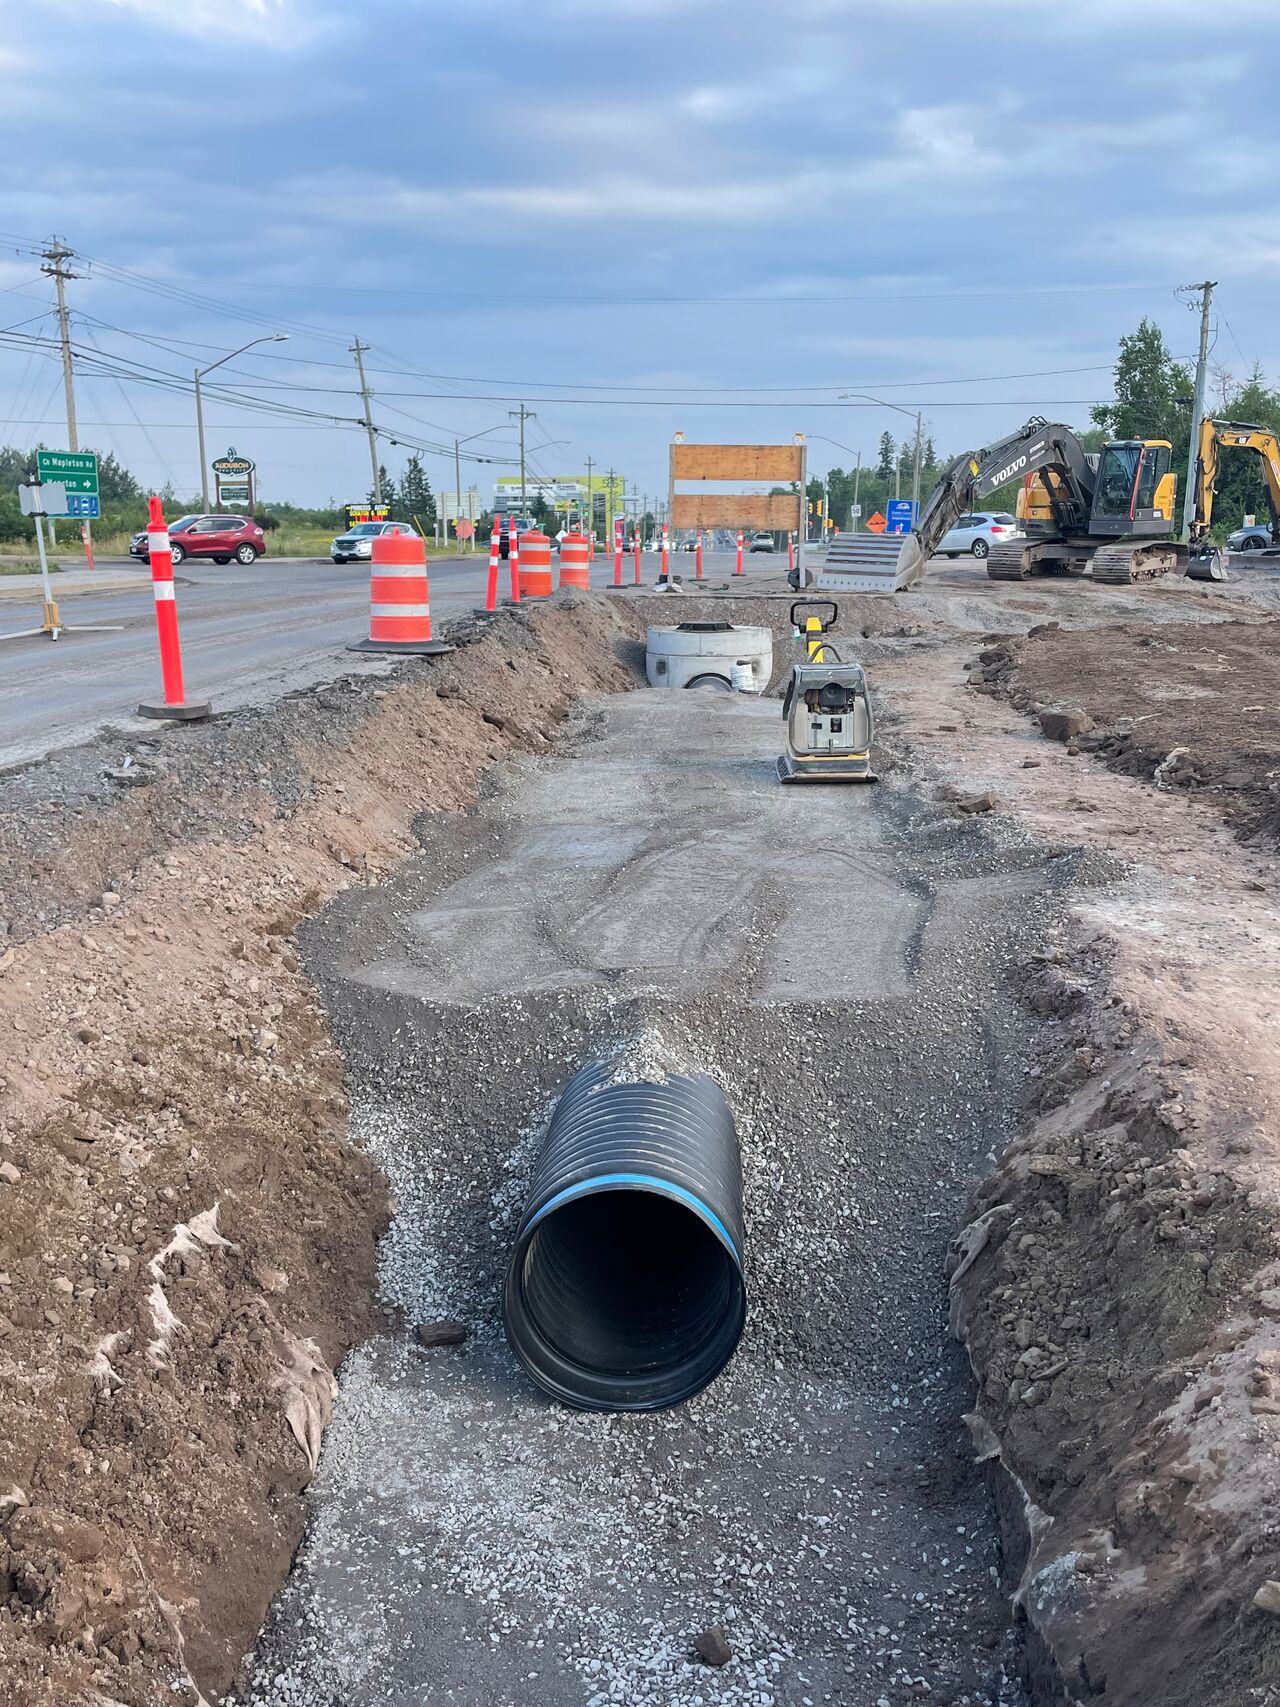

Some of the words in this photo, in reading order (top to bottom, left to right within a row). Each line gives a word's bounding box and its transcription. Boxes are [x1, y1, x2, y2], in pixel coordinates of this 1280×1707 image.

[52, 458, 84, 469] Mapleton
[85, 460, 93, 468] Rd
[991, 455, 1027, 486] VOLVO
